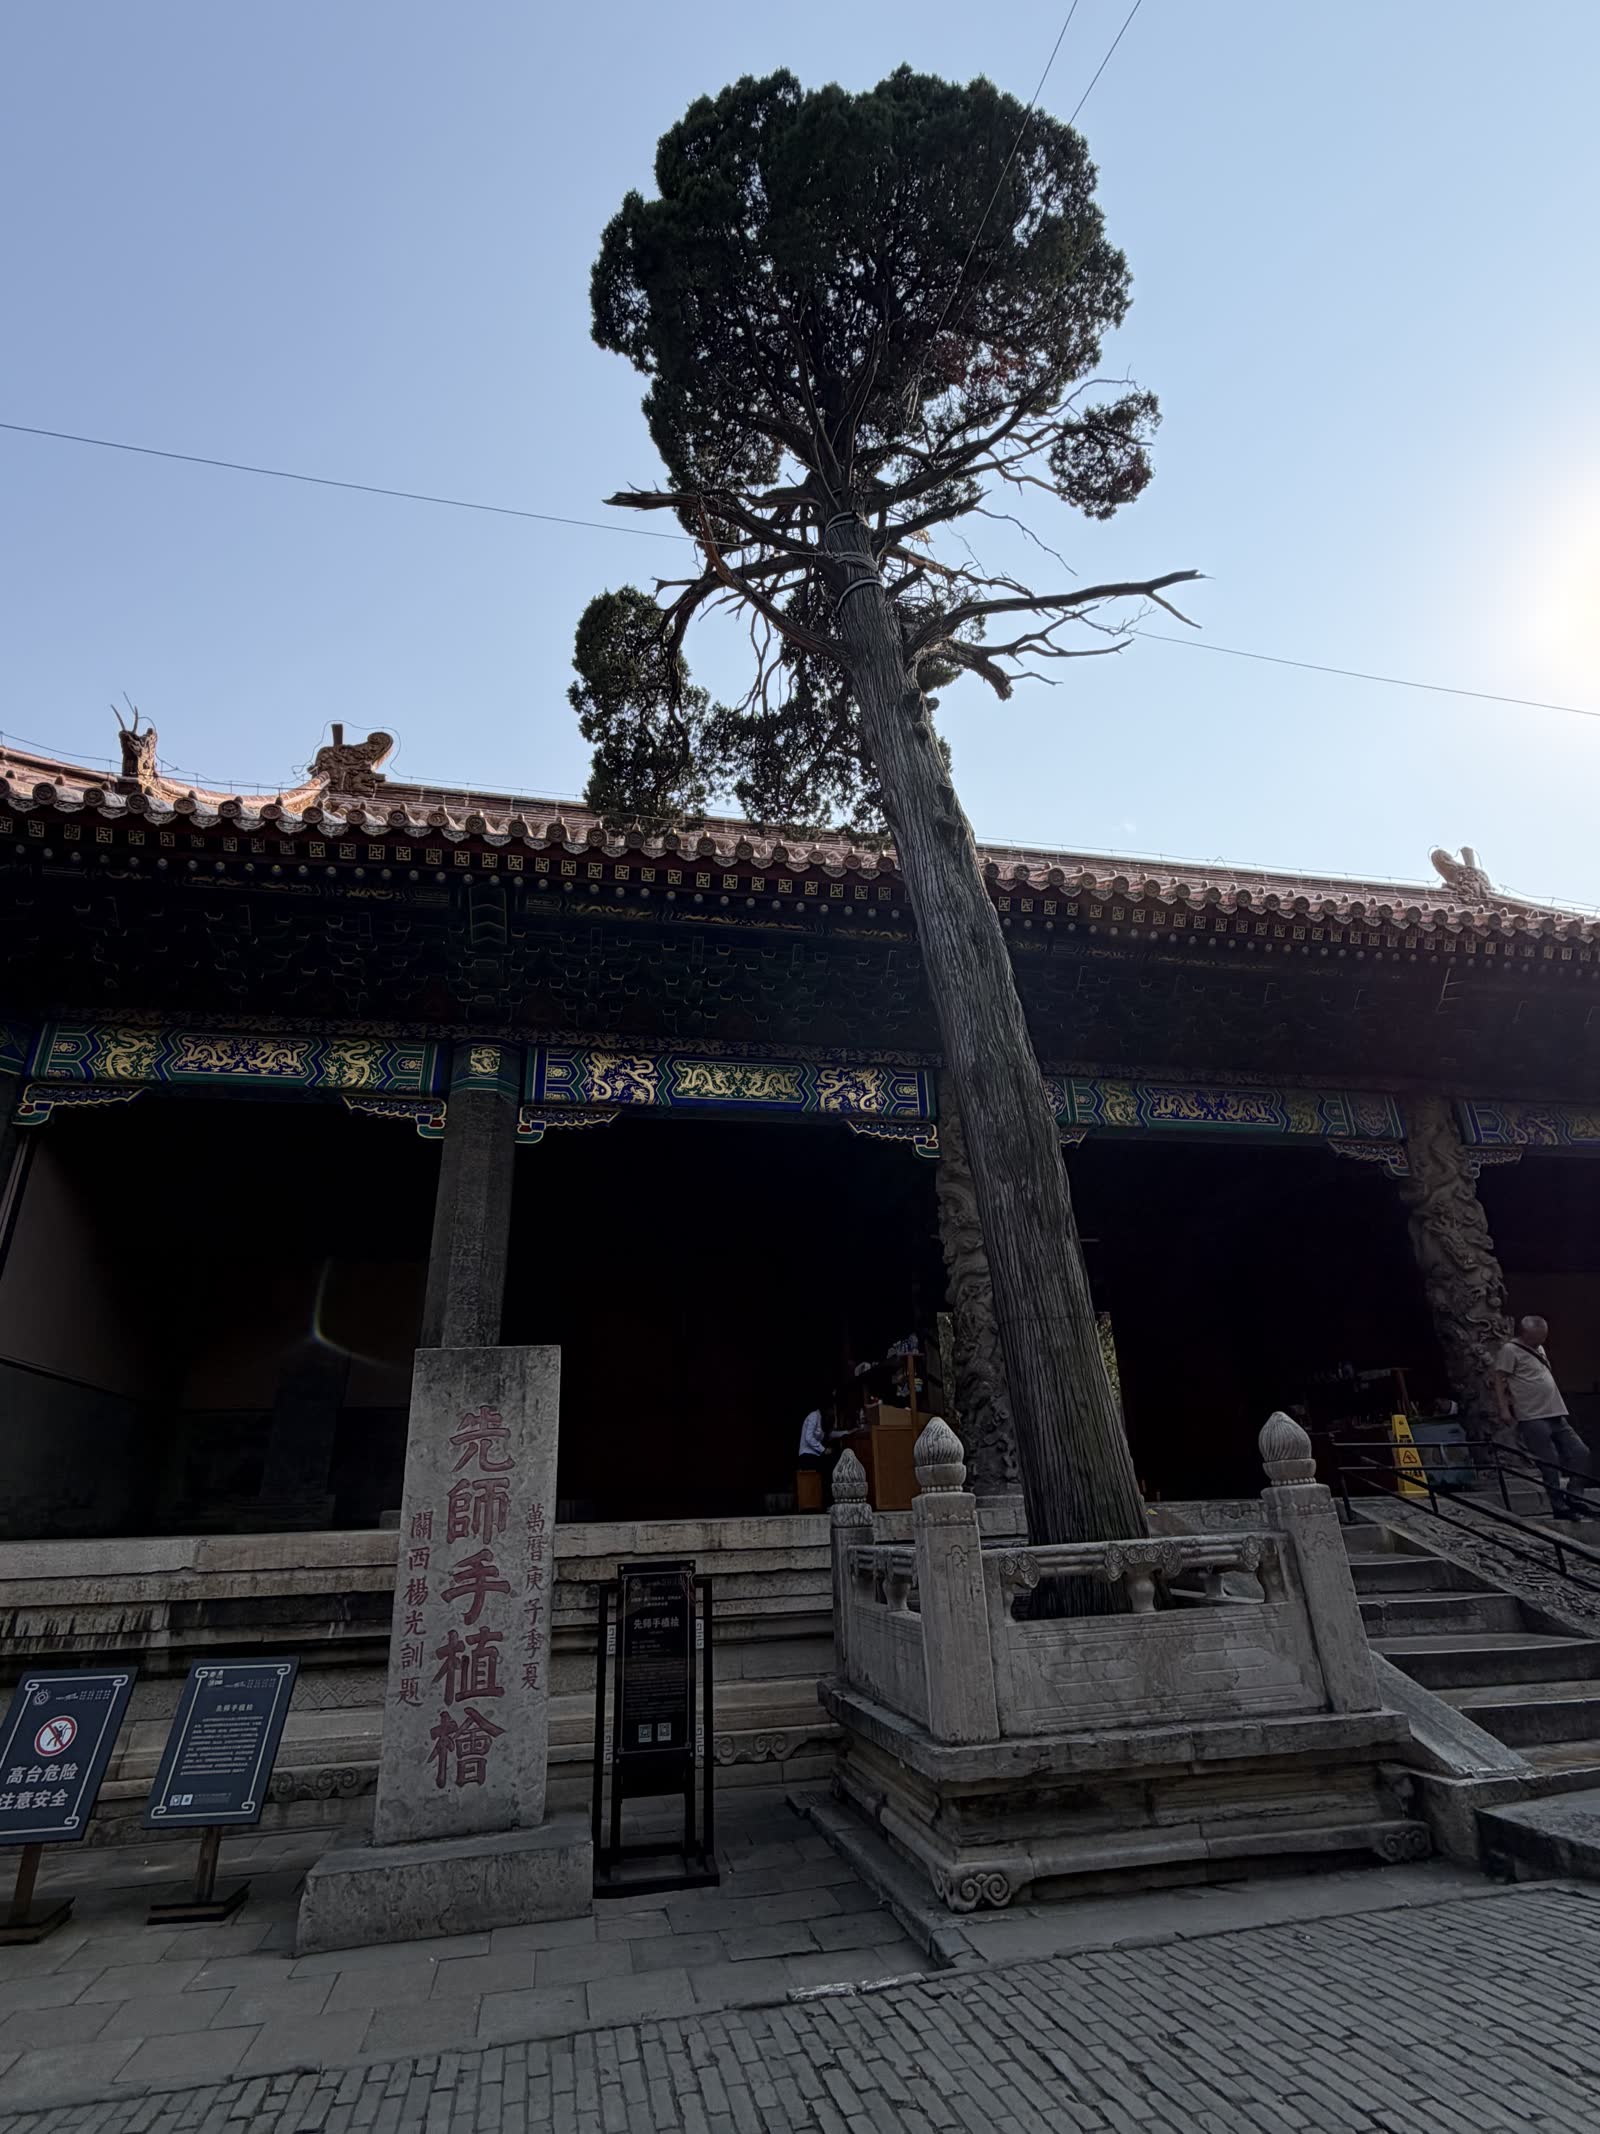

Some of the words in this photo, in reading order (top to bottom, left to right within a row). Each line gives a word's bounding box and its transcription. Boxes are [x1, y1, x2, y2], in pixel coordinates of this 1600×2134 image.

[427, 1405, 515, 1789] 先師手植檜
[6, 1762, 79, 1784] 高台危险
[0, 1788, 69, 1810] 注意安全
